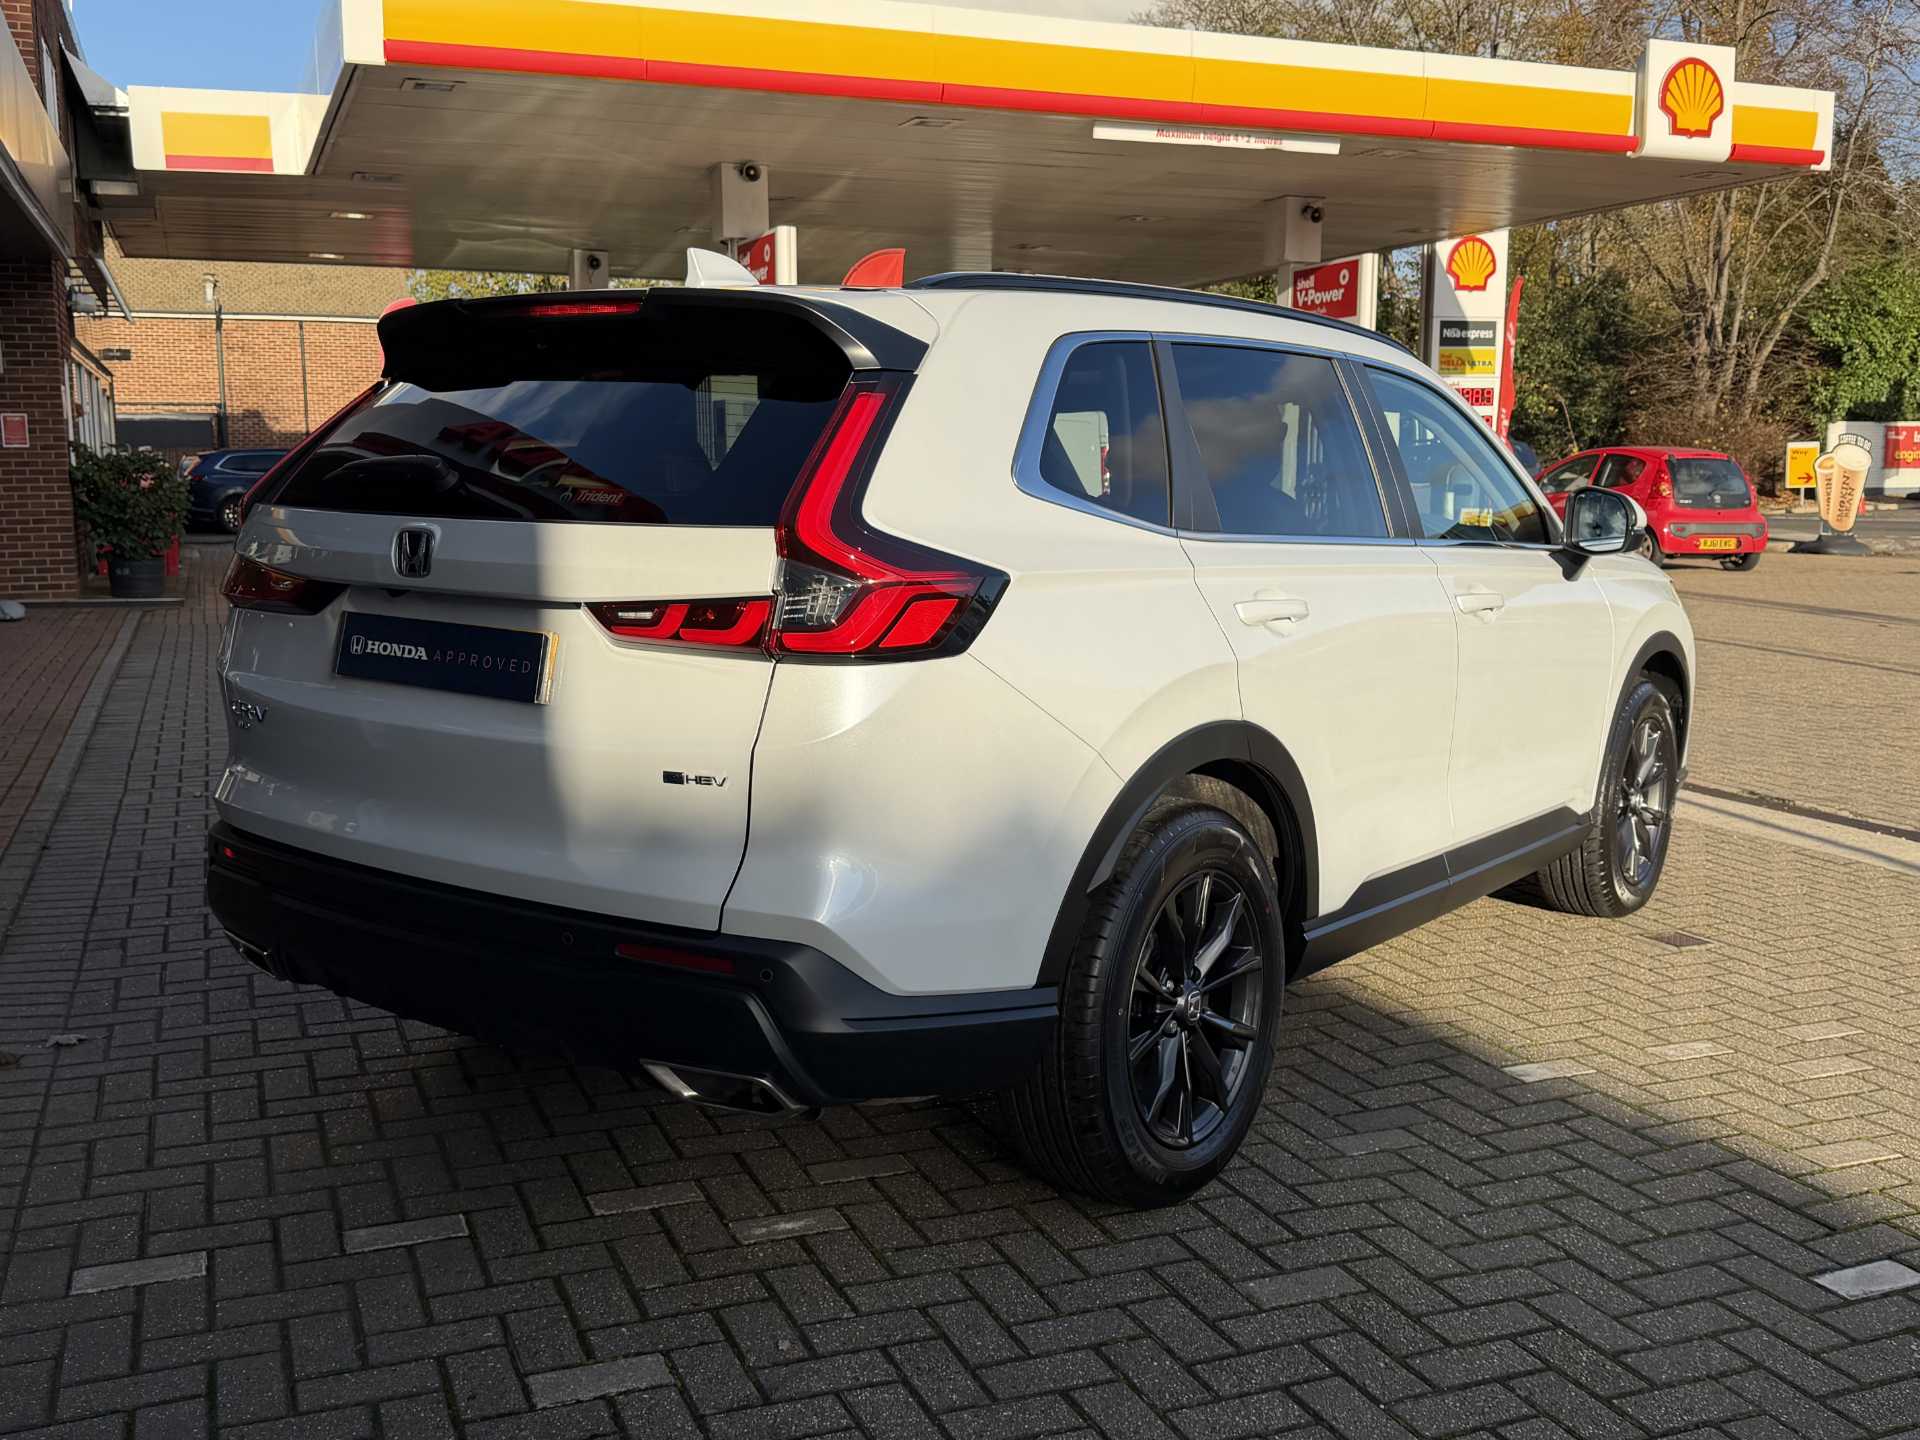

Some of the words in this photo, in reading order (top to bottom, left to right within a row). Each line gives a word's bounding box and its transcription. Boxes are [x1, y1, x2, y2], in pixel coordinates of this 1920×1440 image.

[1156, 128, 1200, 139] Maximum
[1202, 130, 1230, 143] height
[1255, 136, 1282, 145] metres
[1296, 274, 1315, 290] Shell
[1296, 288, 1345, 307] V-Power
[1461, 329, 1493, 340] express
[577, 490, 624, 503] Trident
[366, 640, 428, 661] HONDA
[433, 650, 532, 674] APPROVED
